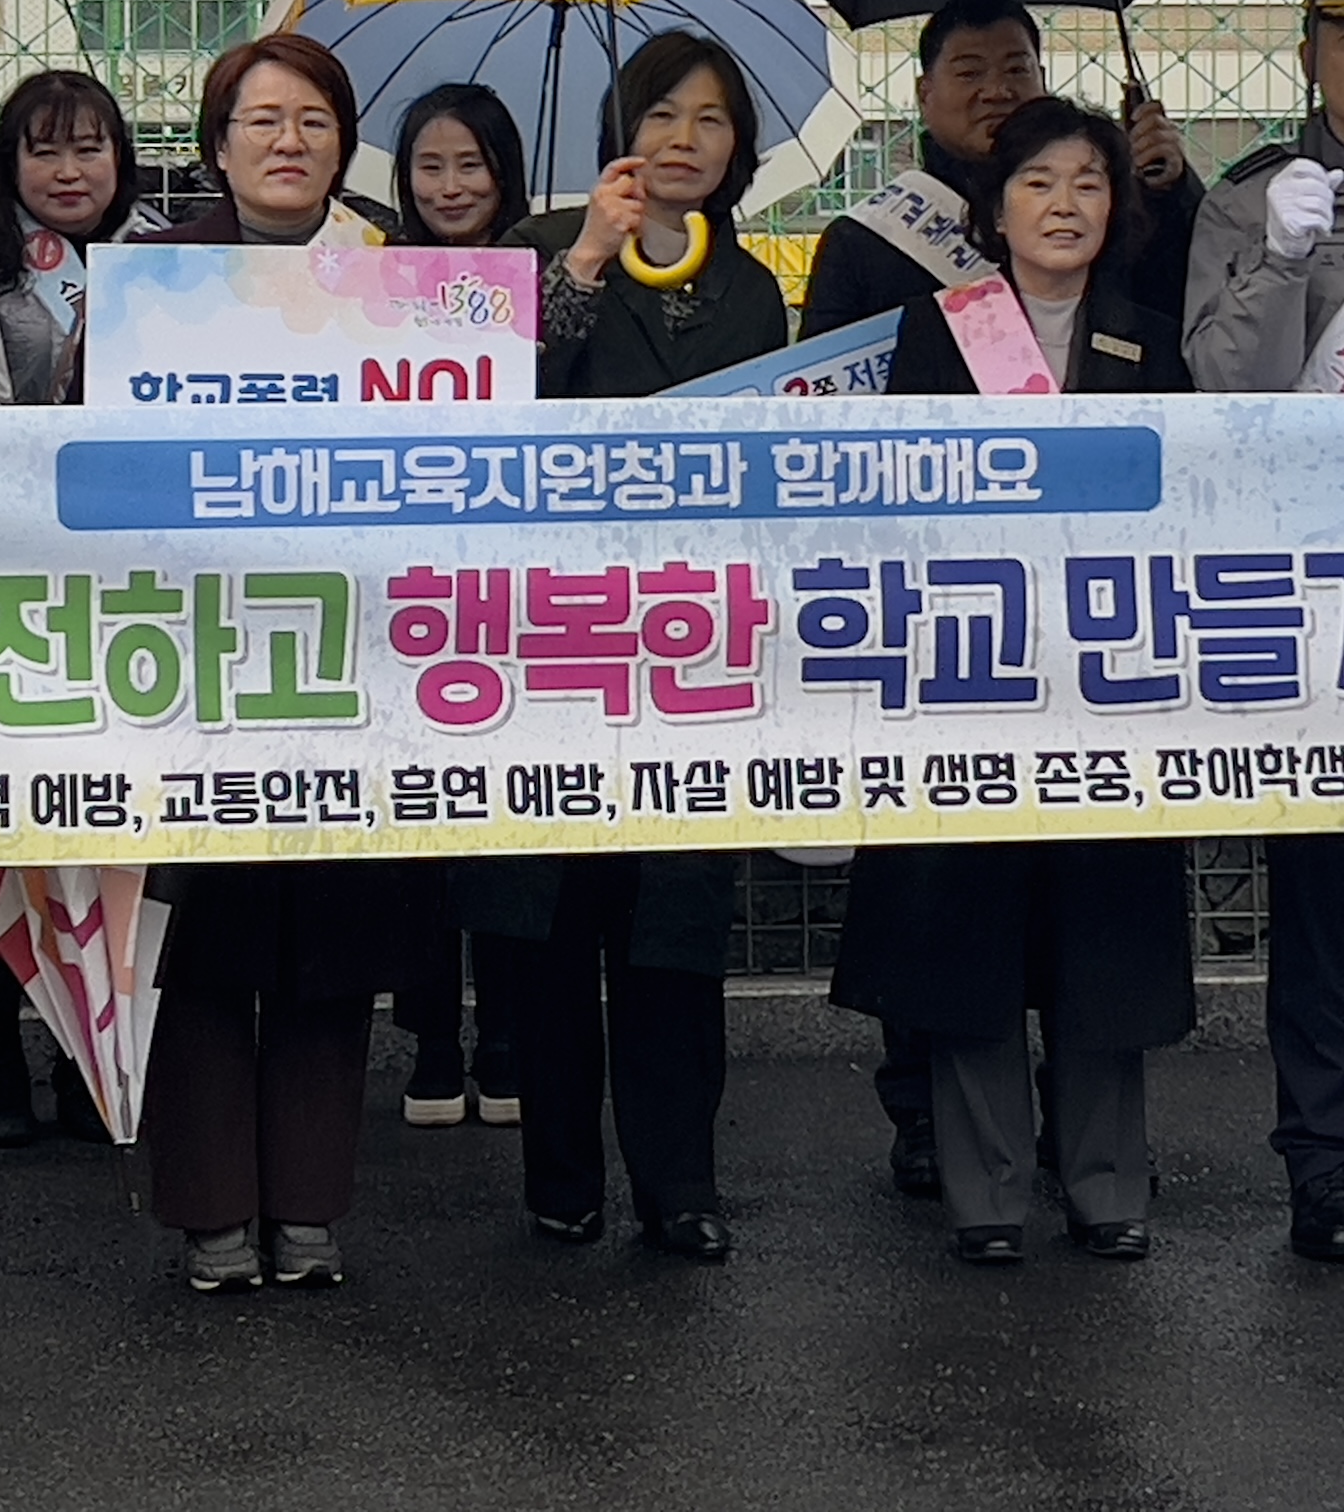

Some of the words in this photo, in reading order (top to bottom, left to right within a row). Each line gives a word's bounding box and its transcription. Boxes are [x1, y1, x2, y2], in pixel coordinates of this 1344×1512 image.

[441, 284, 511, 324] 1388
[189, 439, 746, 521] 남해교육지원청과
[772, 436, 1043, 504] 함께해요
[386, 562, 771, 727] 행복한
[790, 556, 1041, 711] 학교
[30, 773, 143, 832] 예방,
[159, 765, 377, 827] 교통안전,
[390, 763, 489, 820] 흡연
[506, 763, 617, 821] 예방,
[630, 759, 732, 814] 자살
[746, 757, 844, 811] 예방
[861, 756, 905, 808] 및
[922, 752, 1019, 806] 생명
[1033, 750, 1145, 806] 존중,
